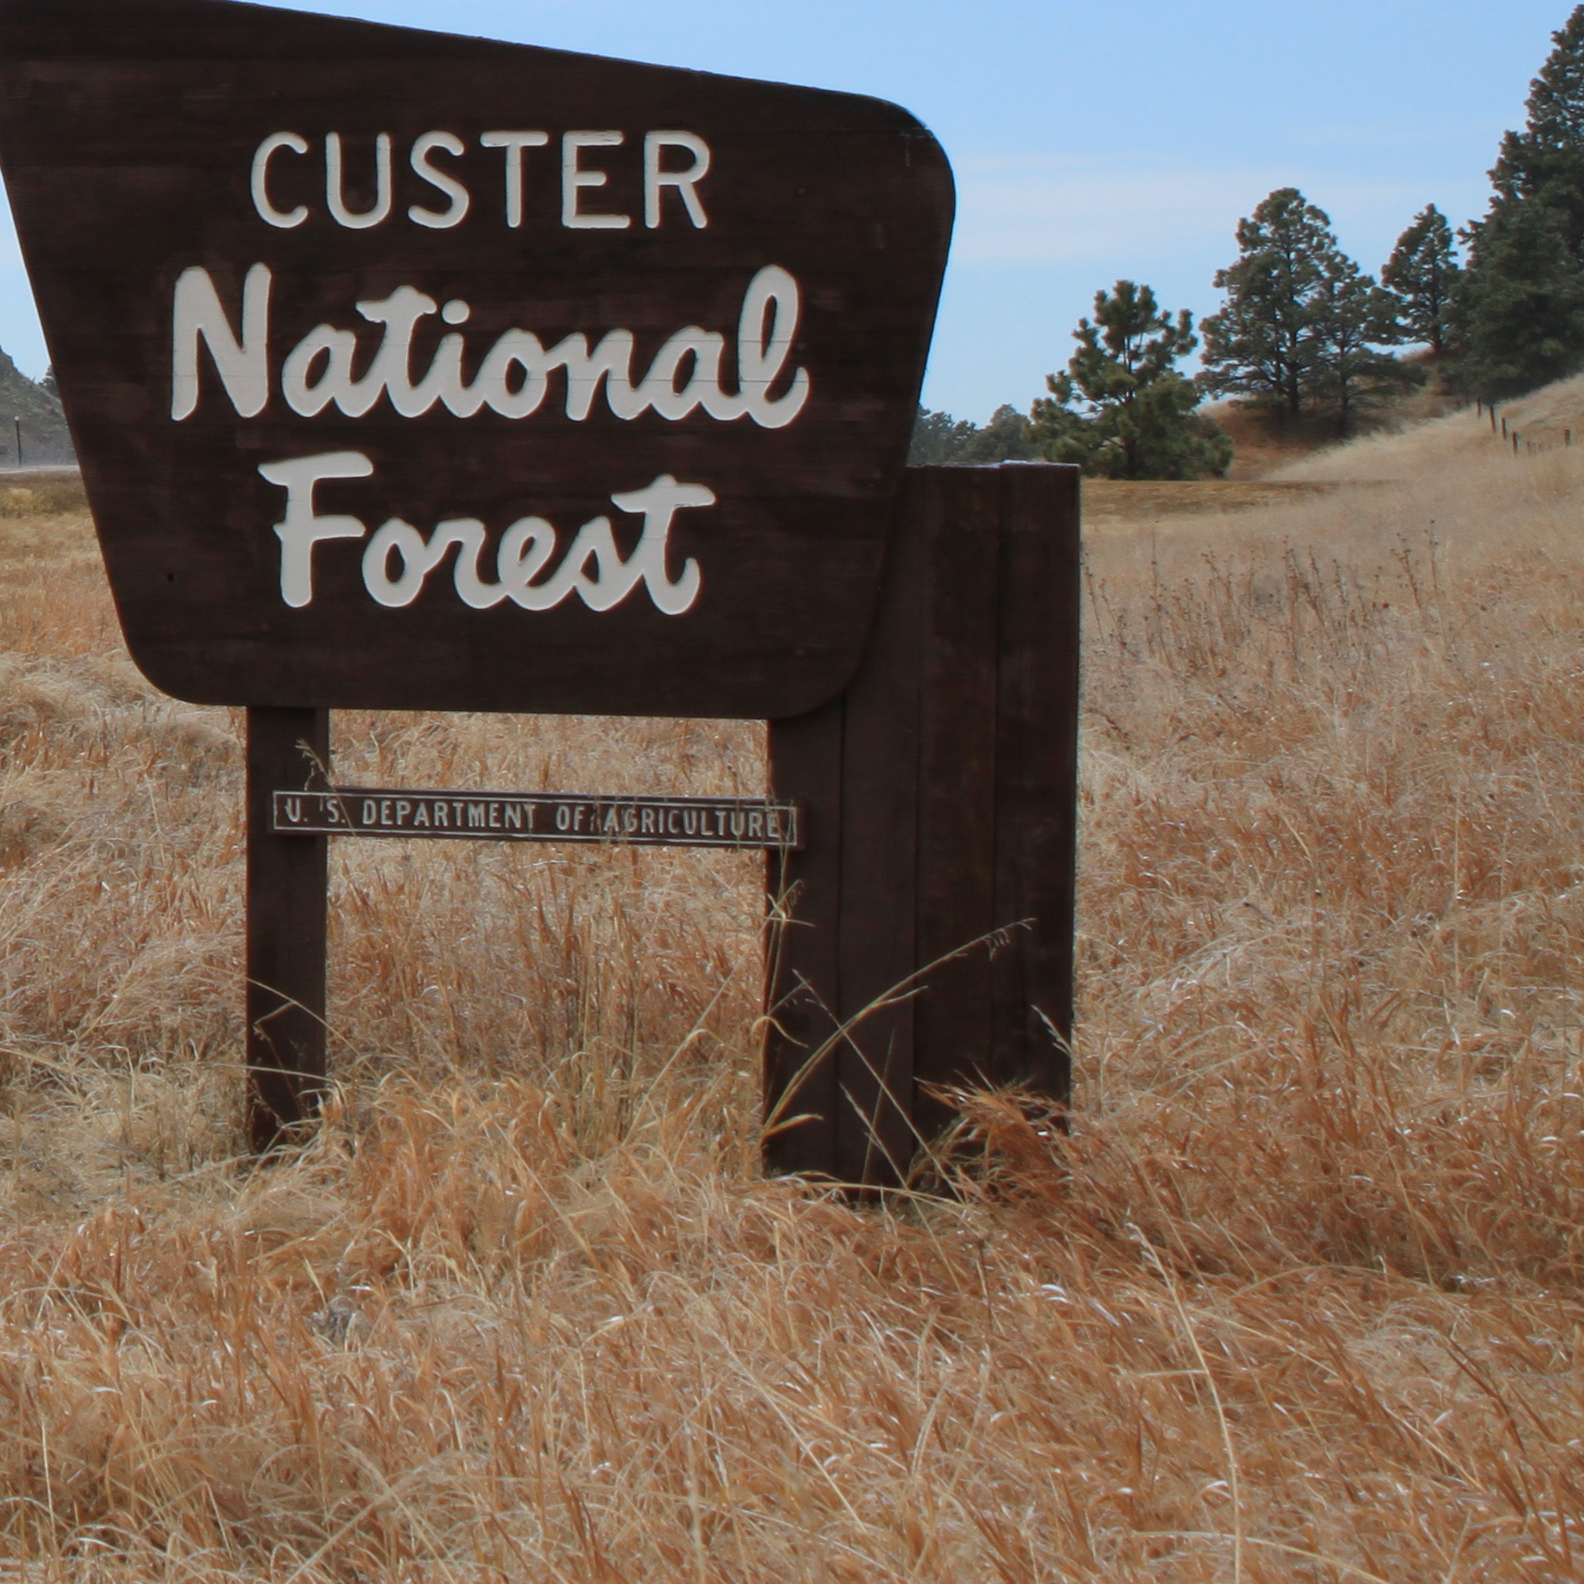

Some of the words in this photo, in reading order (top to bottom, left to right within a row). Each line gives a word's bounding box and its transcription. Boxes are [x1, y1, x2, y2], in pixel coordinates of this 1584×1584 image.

[250, 130, 711, 229] CUSTER
[171, 262, 809, 429] National
[258, 450, 716, 616] Forest
[285, 797, 308, 823] U.
[326, 798, 346, 824] S.
[362, 798, 536, 829] DEPARTMENT
[555, 804, 585, 831] OF
[603, 805, 782, 839] AGRICULTURE
